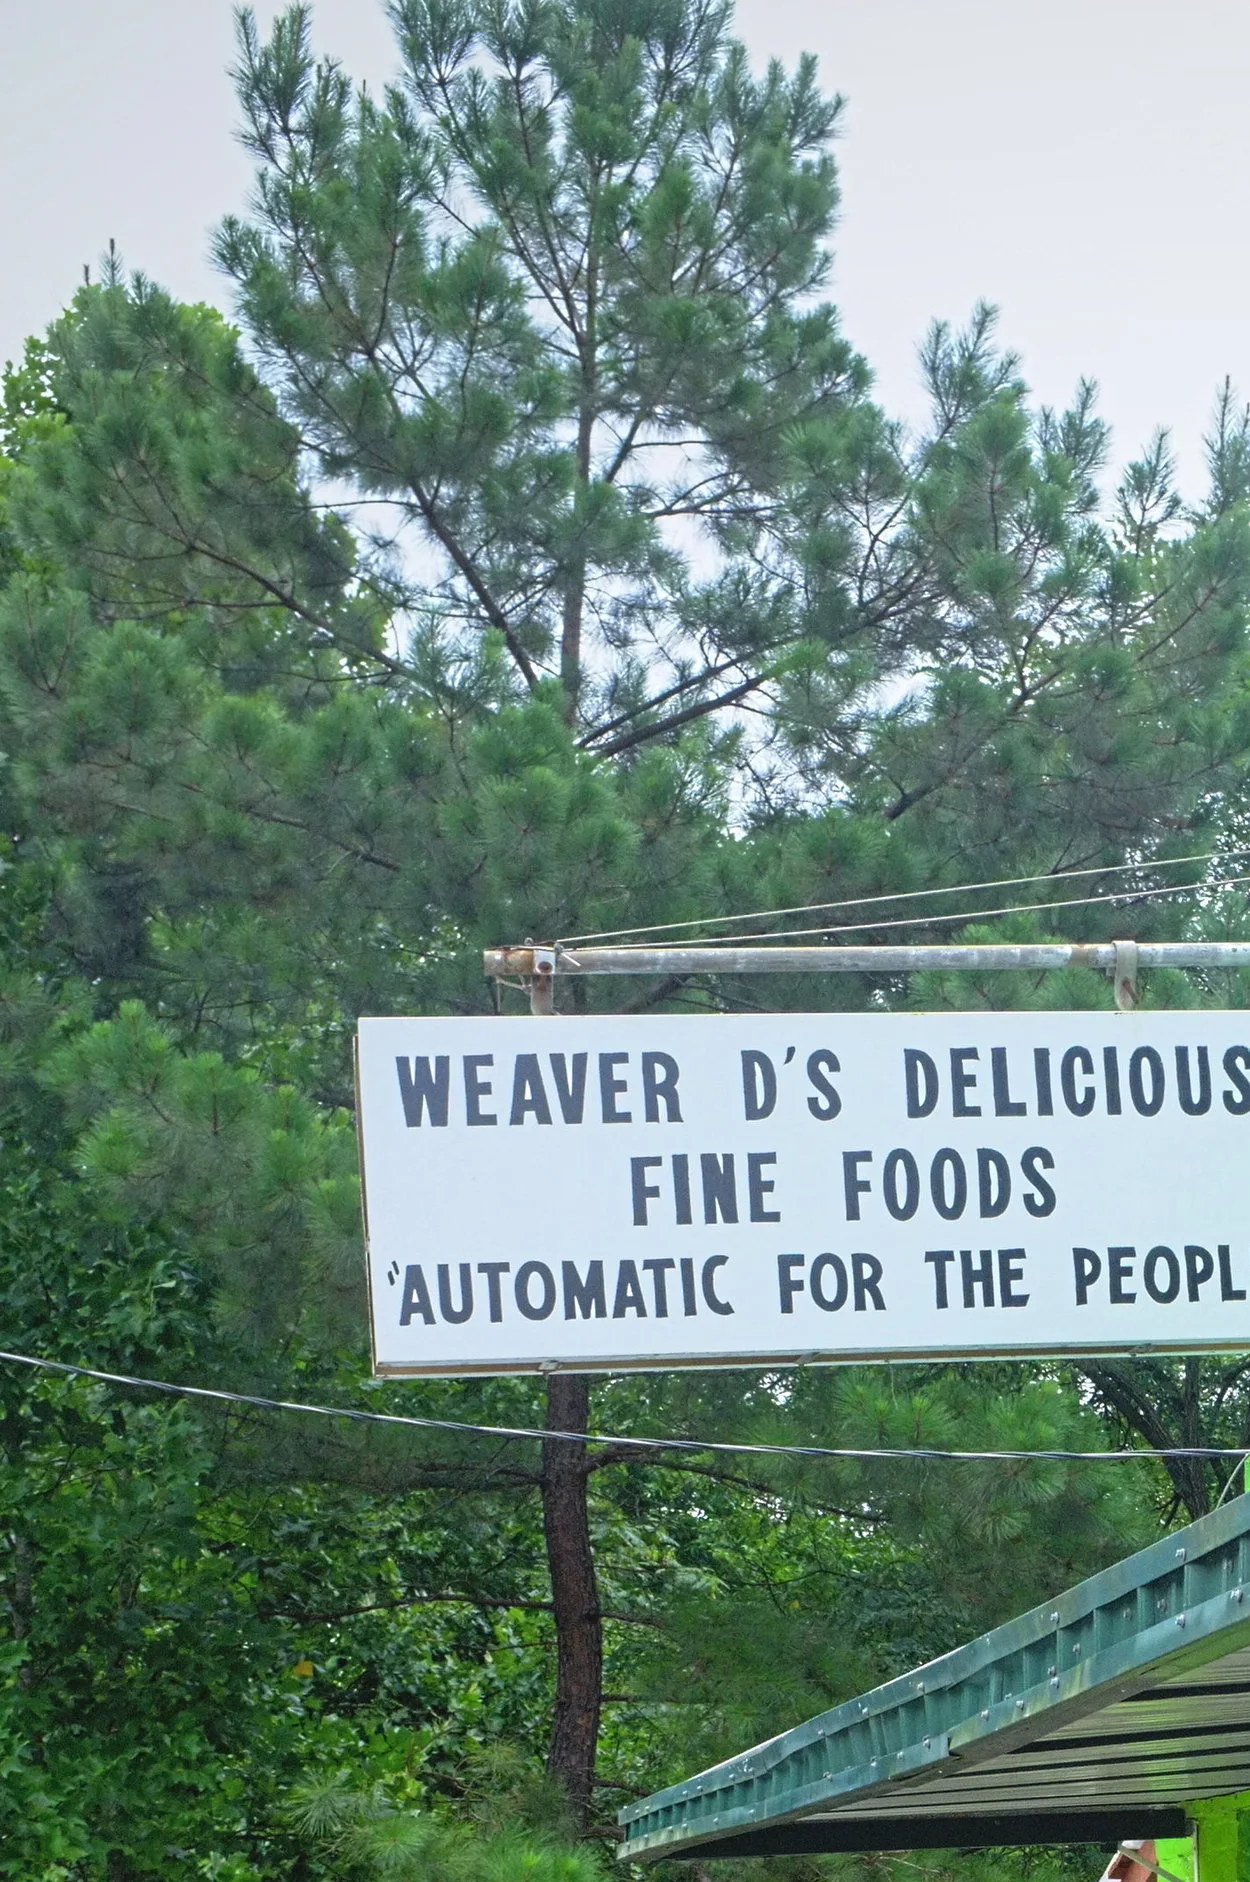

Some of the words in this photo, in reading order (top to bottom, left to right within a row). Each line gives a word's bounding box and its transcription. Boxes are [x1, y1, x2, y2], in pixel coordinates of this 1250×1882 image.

[396, 1052, 683, 1127] WEAVER
[741, 1047, 841, 1120] D'S
[631, 1152, 780, 1225] FINE
[843, 1147, 1056, 1220] FOODS
[778, 1253, 886, 1313] FOR
[925, 1249, 1029, 1309] THE
